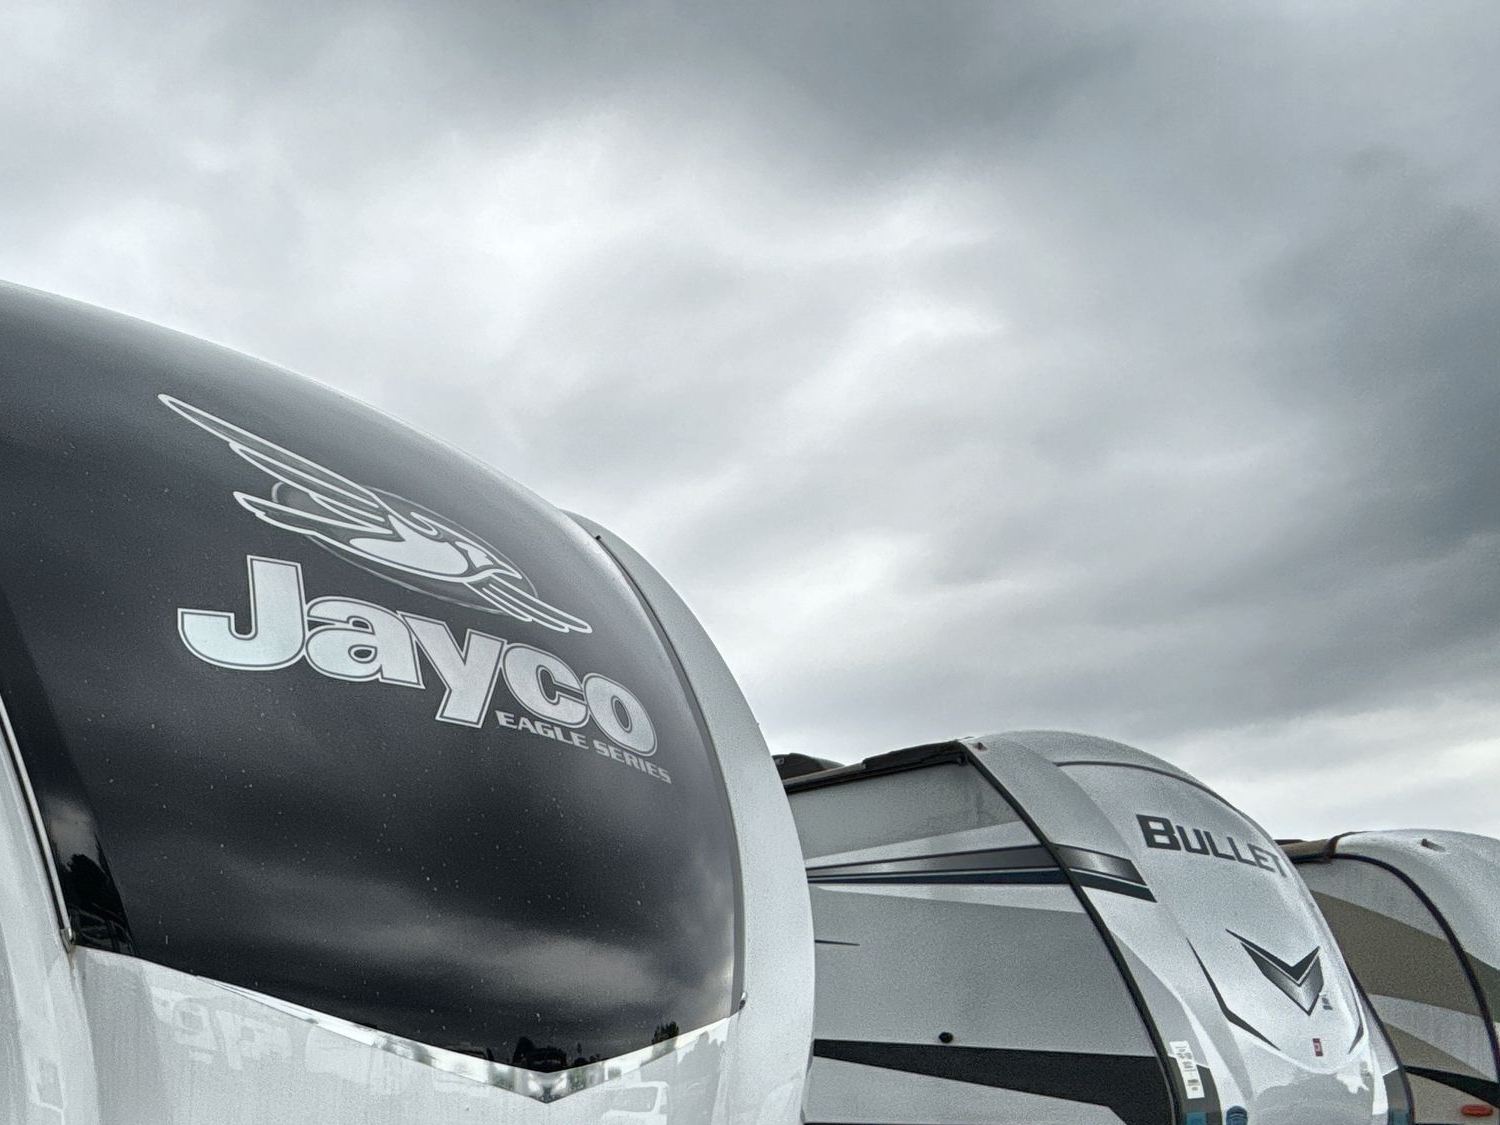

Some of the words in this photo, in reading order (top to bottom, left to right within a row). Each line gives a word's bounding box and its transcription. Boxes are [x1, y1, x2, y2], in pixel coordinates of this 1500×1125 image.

[177, 555, 658, 757] Jayco
[495, 710, 589, 749] EAGLE
[592, 739, 672, 784] SERIES
[1136, 814, 1288, 878] BULLET
